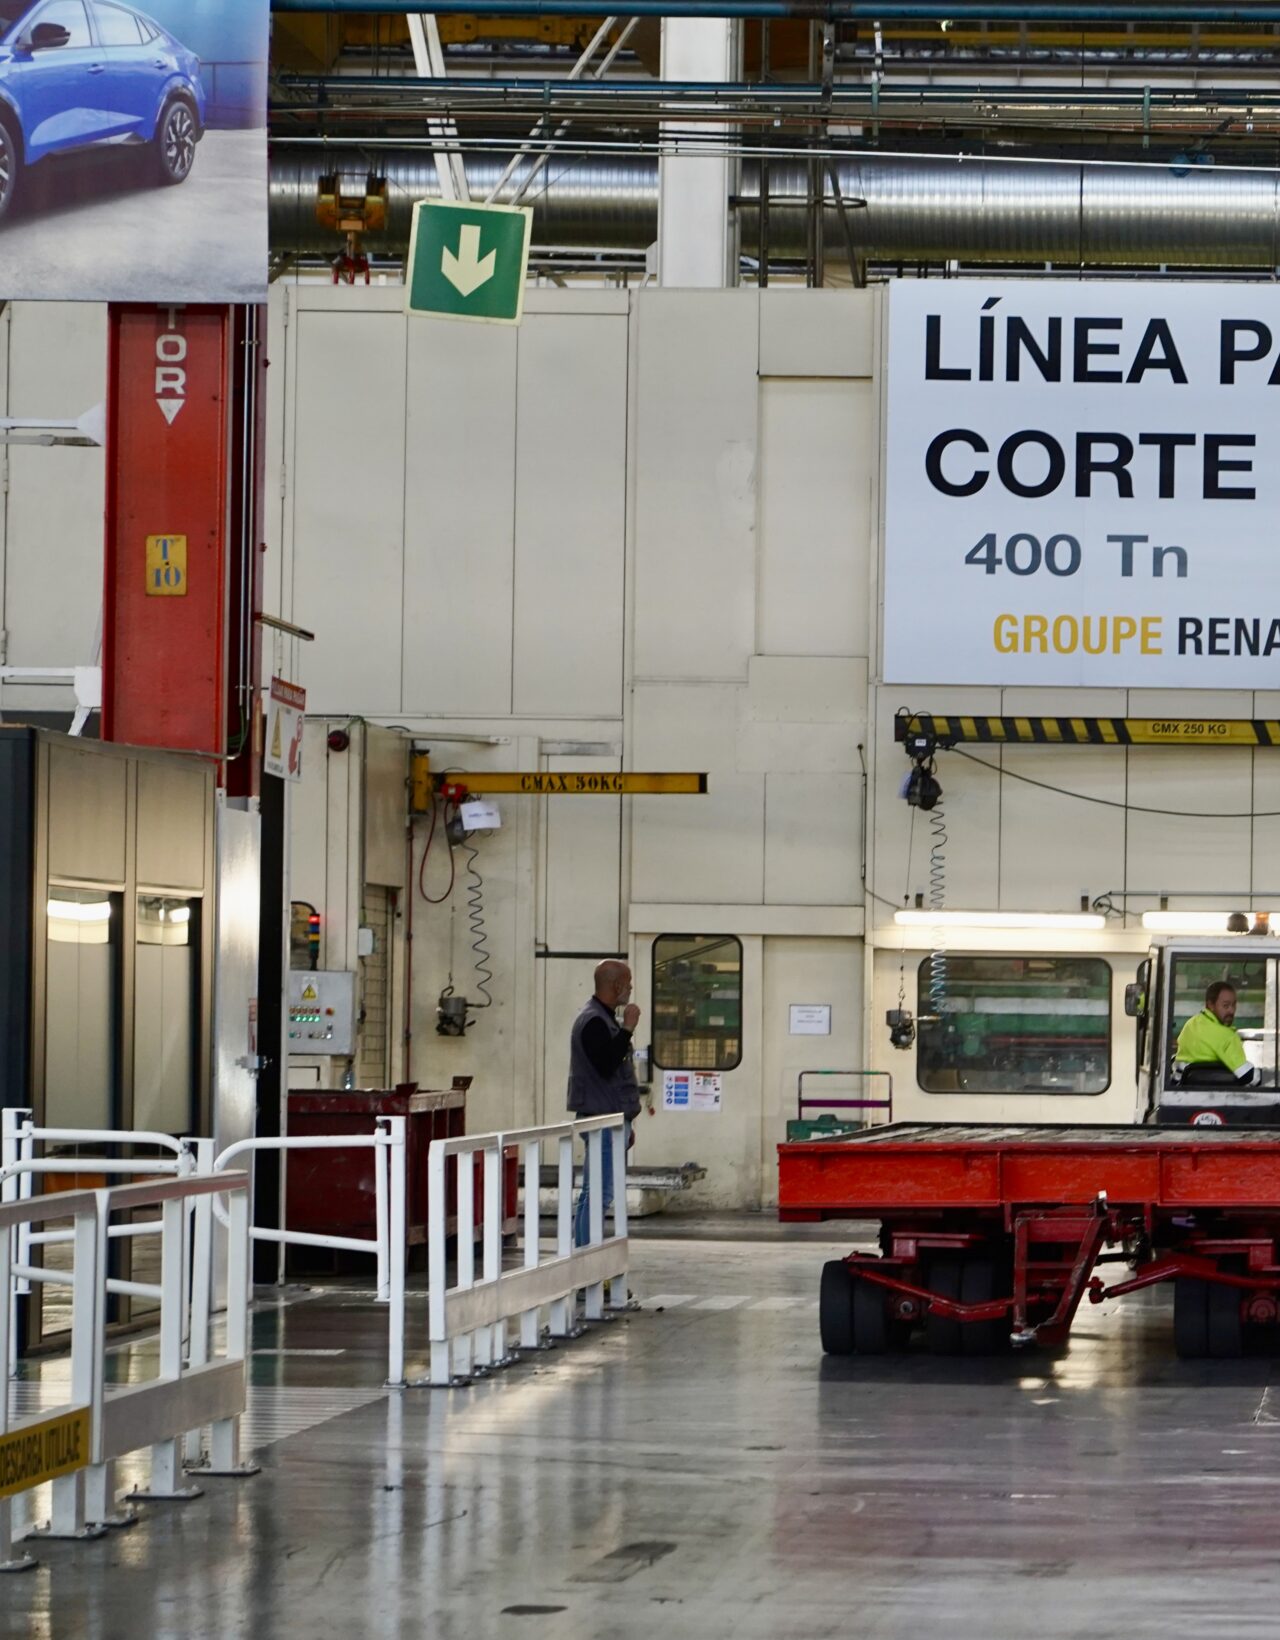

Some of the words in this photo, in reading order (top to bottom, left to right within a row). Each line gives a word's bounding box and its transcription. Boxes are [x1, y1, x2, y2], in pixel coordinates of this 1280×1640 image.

[924, 296, 1189, 385] LÍNEA
[924, 427, 1257, 500] CORTE
[964, 532, 1083, 578] 400
[1106, 533, 1189, 579] Tn
[993, 613, 1164, 655] GROUPE
[1152, 722, 1180, 734] CMX
[1183, 723, 1204, 734] 250
[1208, 724, 1227, 735] KG
[520, 775, 568, 791] CMAX
